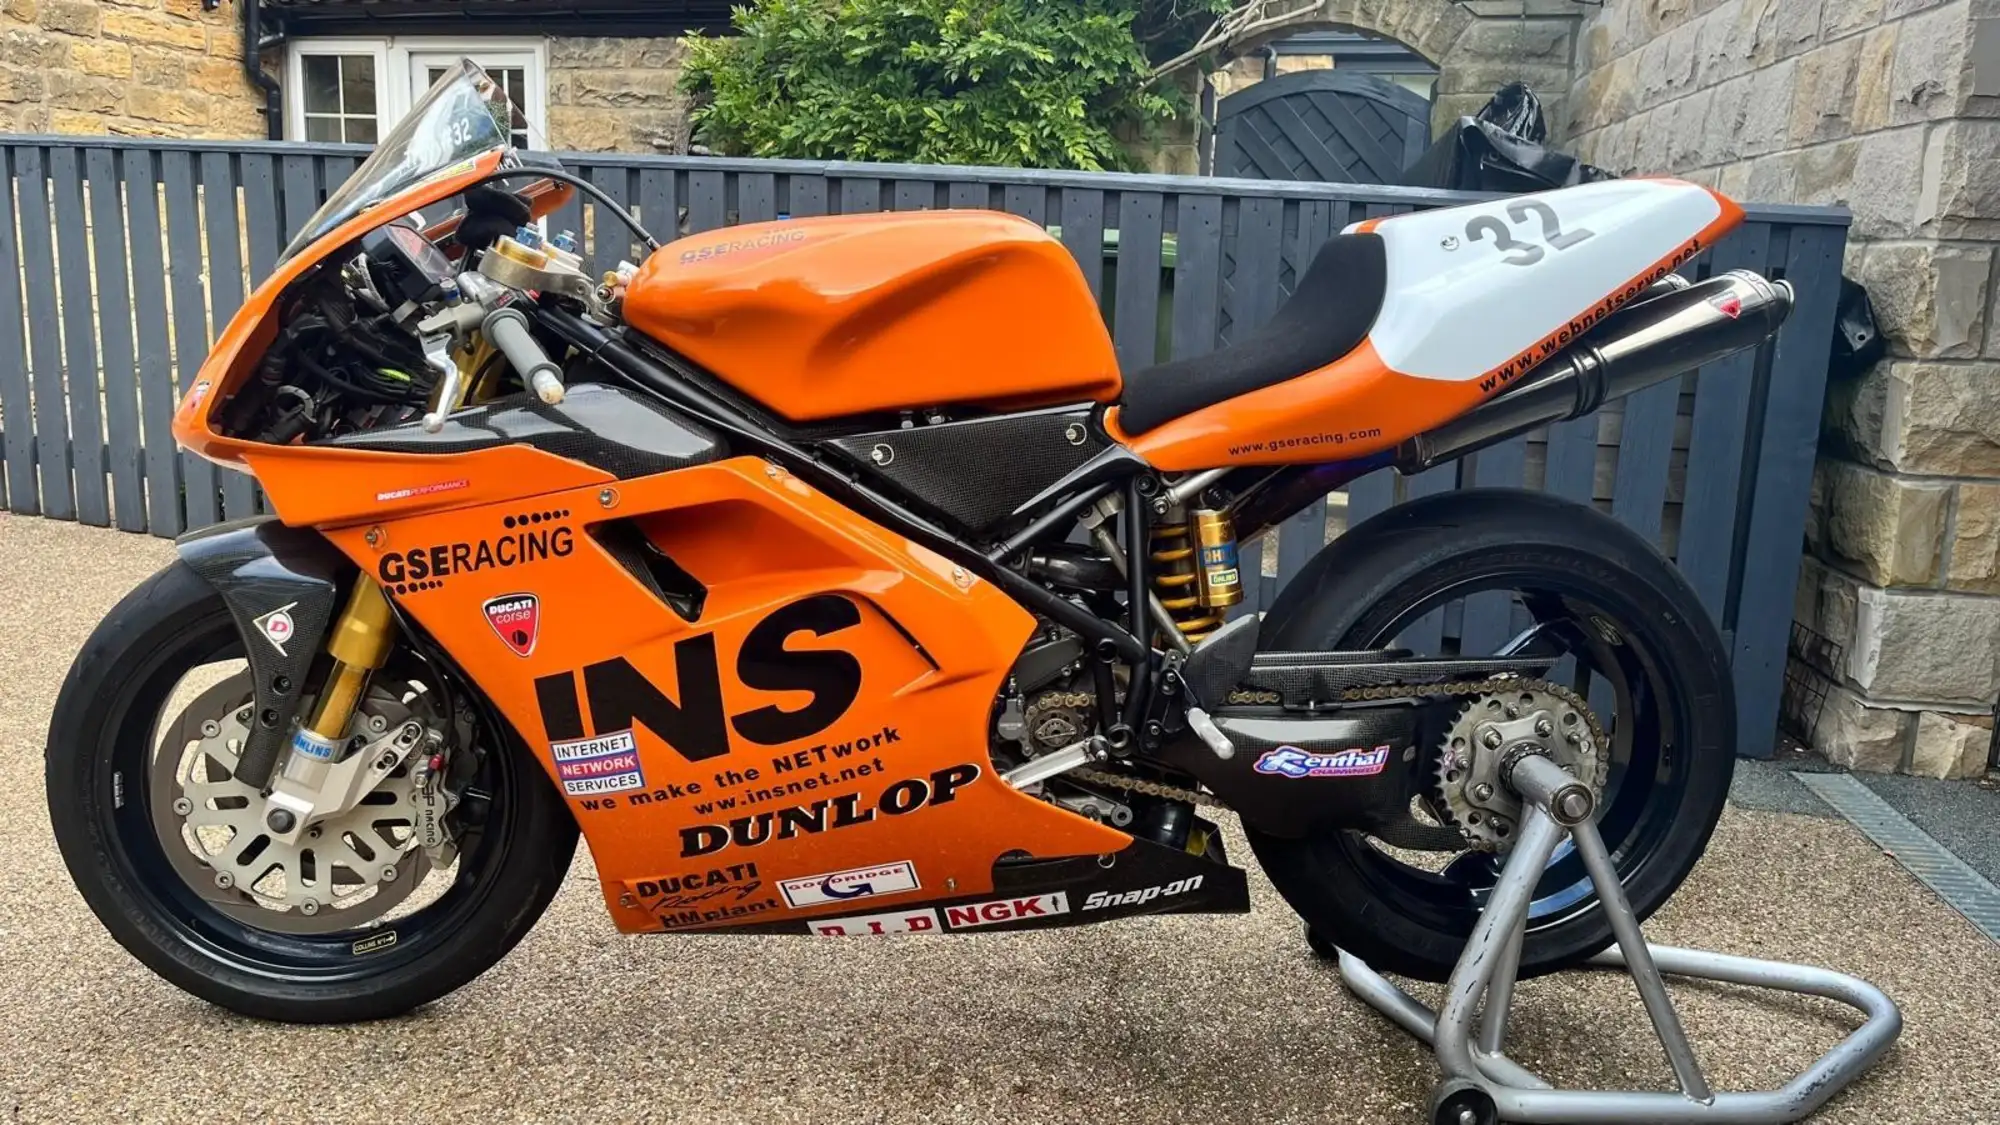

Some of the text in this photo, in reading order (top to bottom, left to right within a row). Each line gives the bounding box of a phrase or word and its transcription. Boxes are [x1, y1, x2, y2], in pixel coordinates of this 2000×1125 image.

[1465, 199, 1596, 267] 32
[1479, 238, 1702, 394] www.webnetserve.net
[1228, 428, 1381, 456] www.gseracing.com
[379, 526, 573, 583] GSERACING
[489, 599, 532, 615] DUCATI
[496, 609, 531, 624] corse
[534, 594, 862, 763] INS
[557, 736, 628, 759] INTERNET
[1260, 749, 1385, 775] Renthal
[562, 755, 636, 776] NETWORK
[580, 726, 902, 811] we make the NETwork
[567, 774, 637, 793] SERVICES
[694, 757, 885, 815] ww.insnet.net
[679, 763, 982, 858] DUNLOP
[636, 862, 758, 897] DUCATI
[788, 867, 905, 891] GOODRIDGE
[1081, 874, 1204, 911] Snap-on
[947, 895, 1048, 926] NGK
